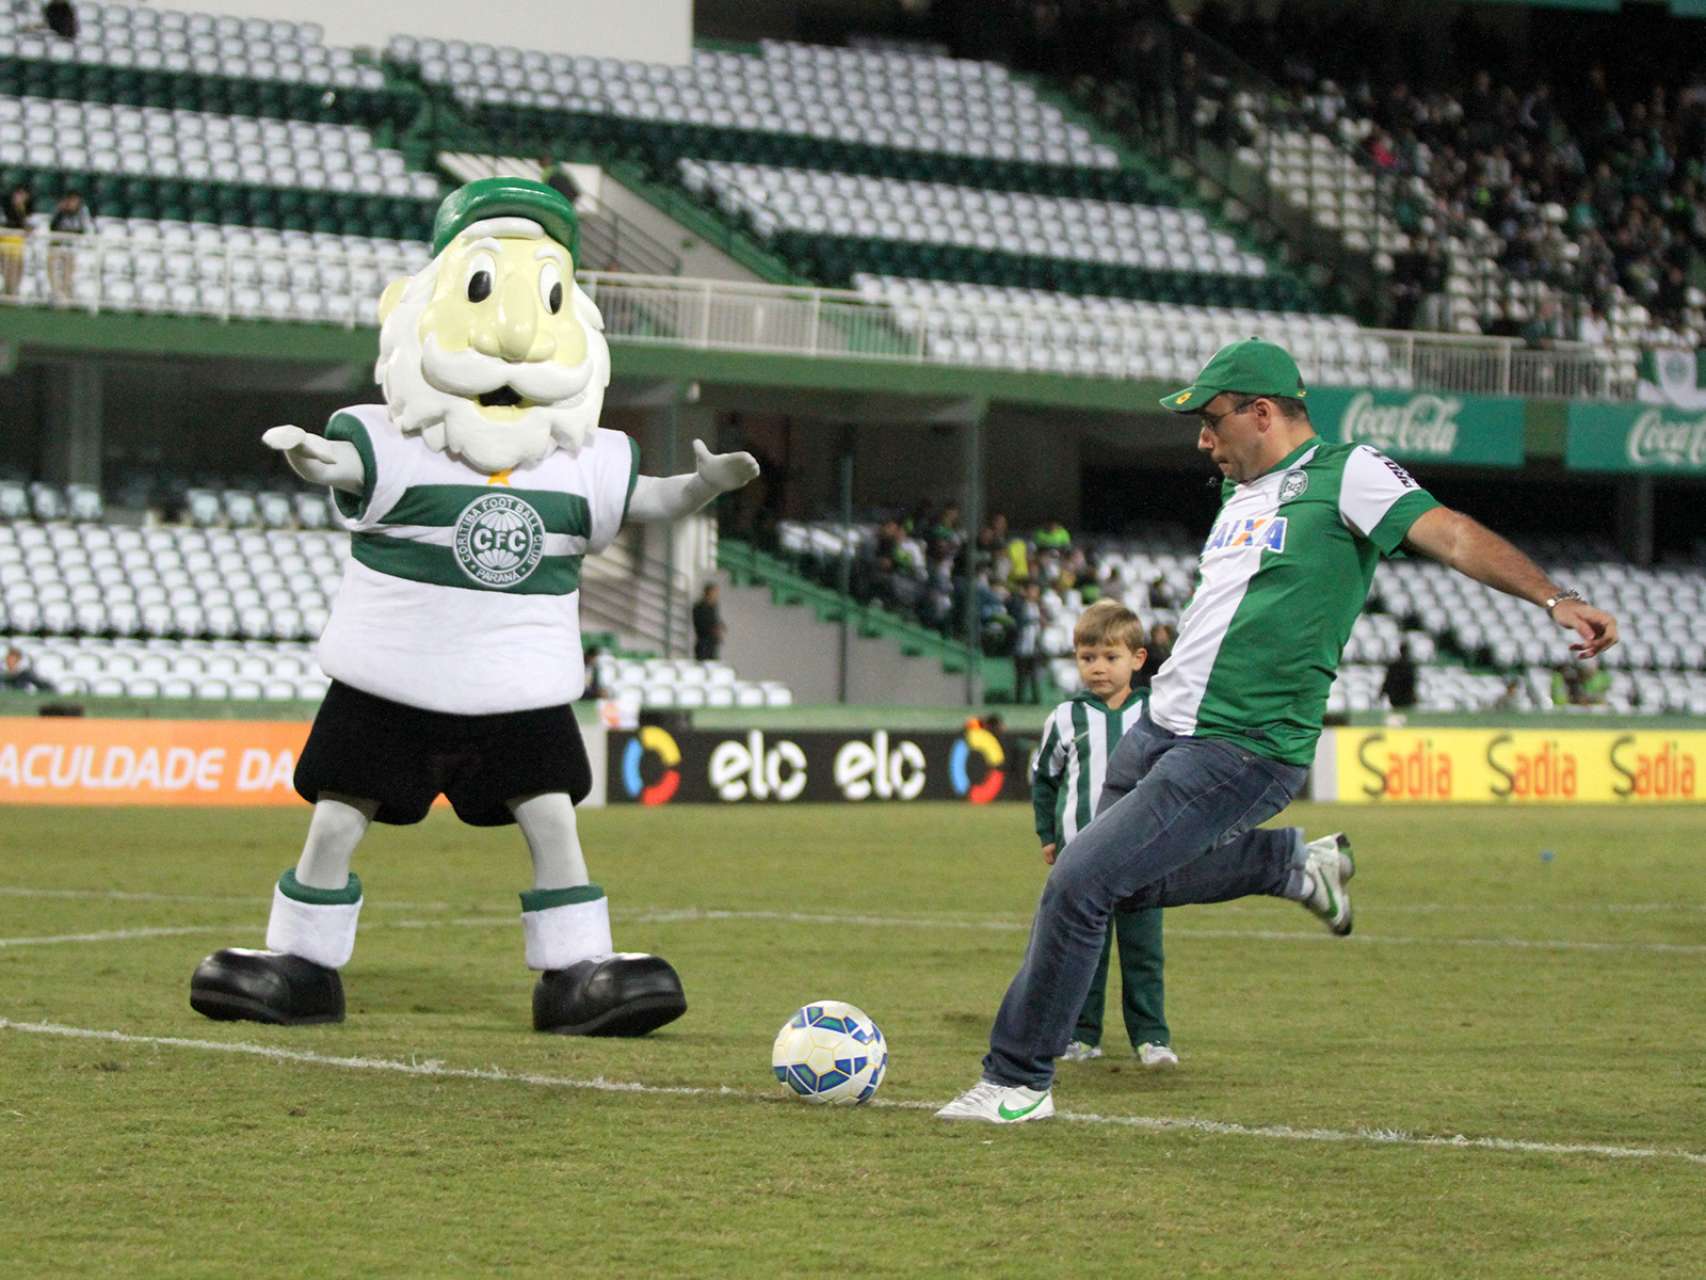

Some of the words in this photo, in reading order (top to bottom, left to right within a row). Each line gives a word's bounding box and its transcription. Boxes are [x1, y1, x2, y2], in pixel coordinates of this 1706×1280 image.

[459, 508, 482, 563] CORITIBA
[482, 497, 515, 511] FOOT
[515, 503, 540, 532] BALL
[473, 528, 527, 552] CFC
[236, 748, 294, 792] DA
[1358, 732, 1453, 799] Sadia
[1486, 732, 1578, 799] Sadia
[1610, 732, 1696, 799] Sadia
